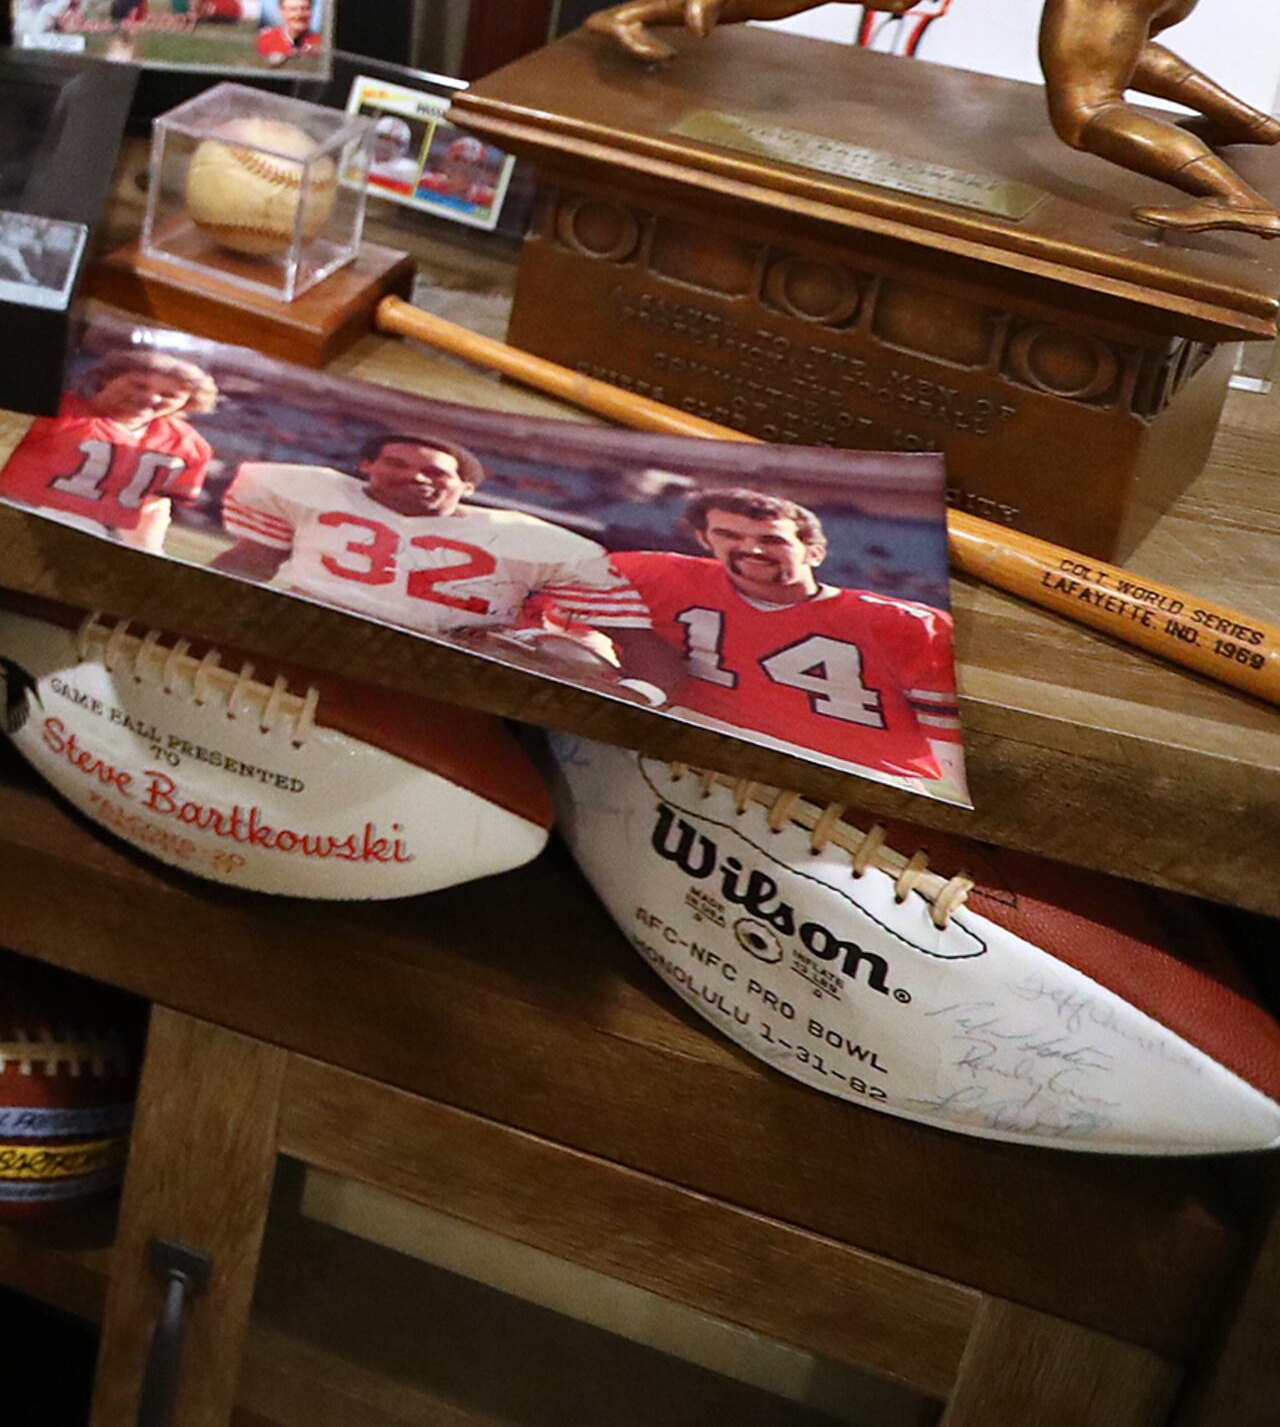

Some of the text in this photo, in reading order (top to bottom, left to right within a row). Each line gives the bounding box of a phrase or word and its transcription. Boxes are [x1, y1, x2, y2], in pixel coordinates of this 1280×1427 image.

[49, 438, 187, 510] 10
[316, 510, 499, 616] 32
[1059, 559, 1267, 647] COLT WORLD SERIES
[674, 604, 890, 732] 14
[1213, 638, 1268, 671] 1969
[51, 678, 306, 794] GAME BALL PRESENTED
[150, 743, 182, 768] TO
[42, 716, 134, 798] Steve
[143, 770, 414, 863] Bartkowski
[651, 802, 890, 996] Wilson
[635, 907, 738, 982] AFC-NFC
[747, 978, 796, 1021] PRO
[807, 1018, 889, 1074] BOWL
[759, 1022, 888, 1102] 1-31-82
